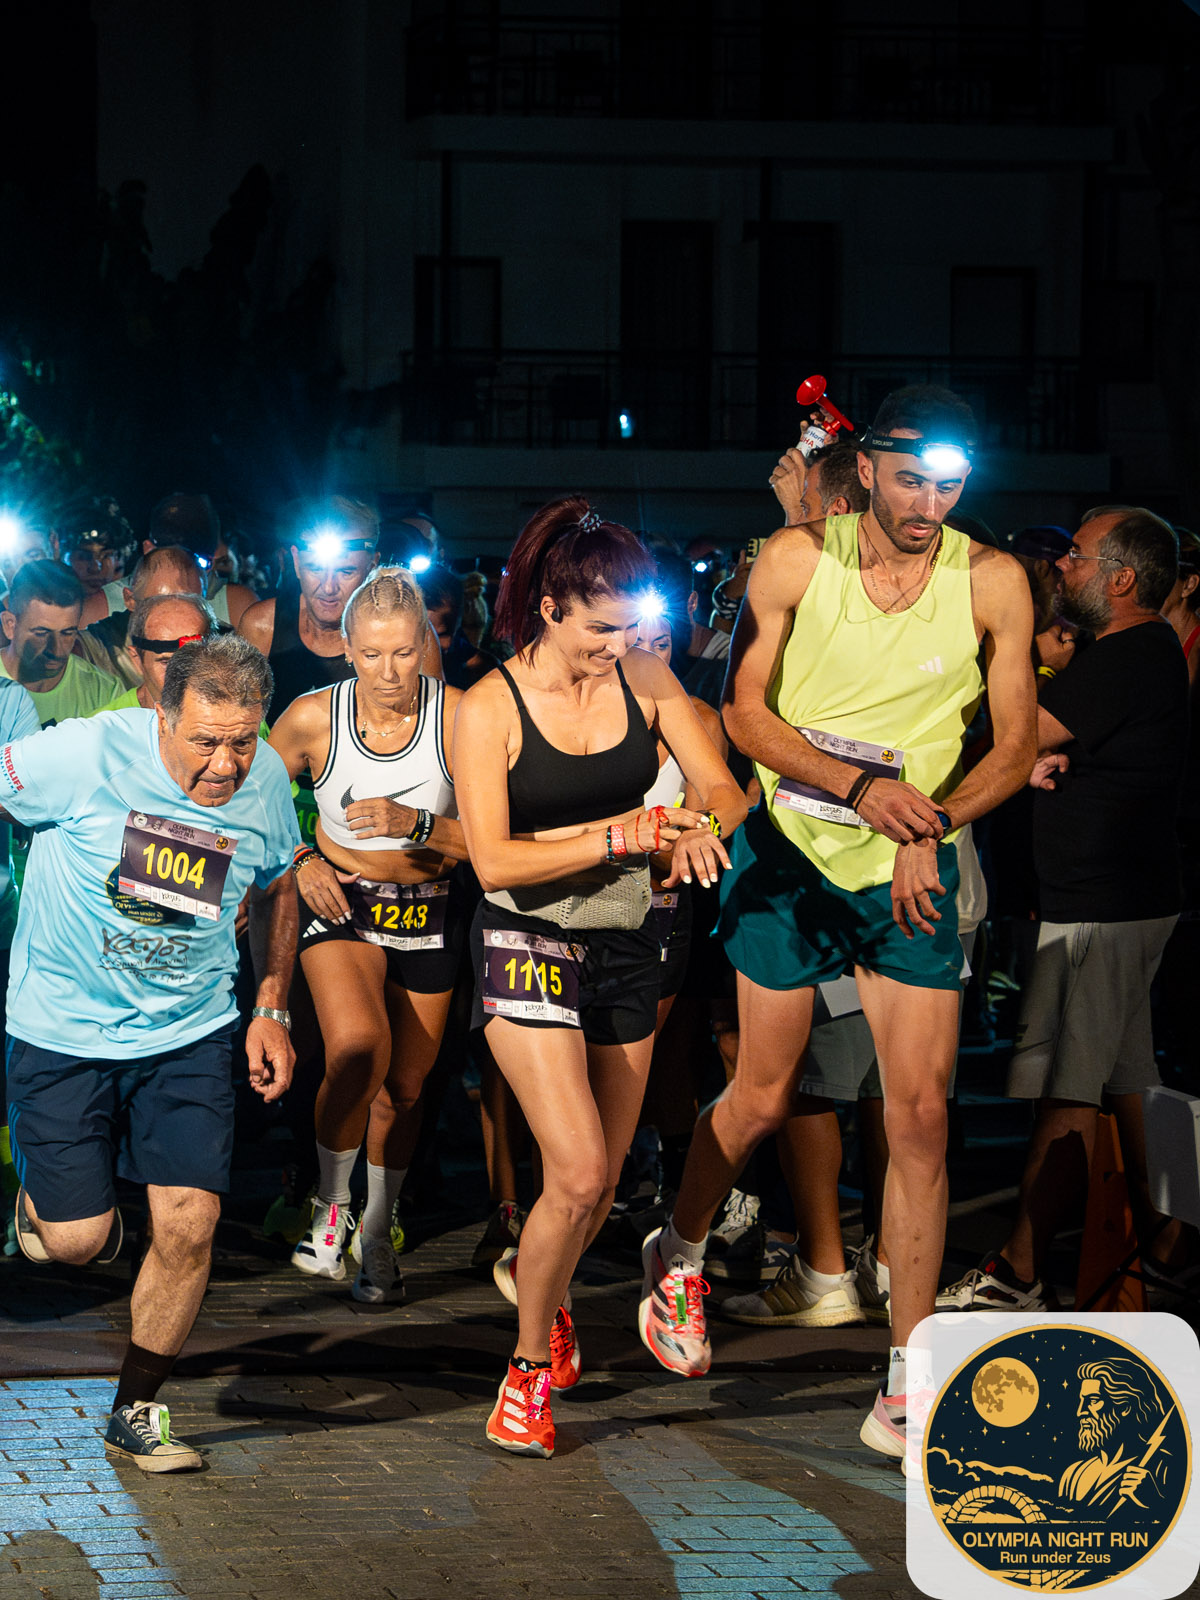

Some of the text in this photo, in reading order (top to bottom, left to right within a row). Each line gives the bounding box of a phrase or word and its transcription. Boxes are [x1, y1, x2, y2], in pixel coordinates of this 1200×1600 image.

[4, 745, 25, 791] INTERLIFE
[143, 843, 206, 890] 1004
[505, 957, 562, 996] 1115
